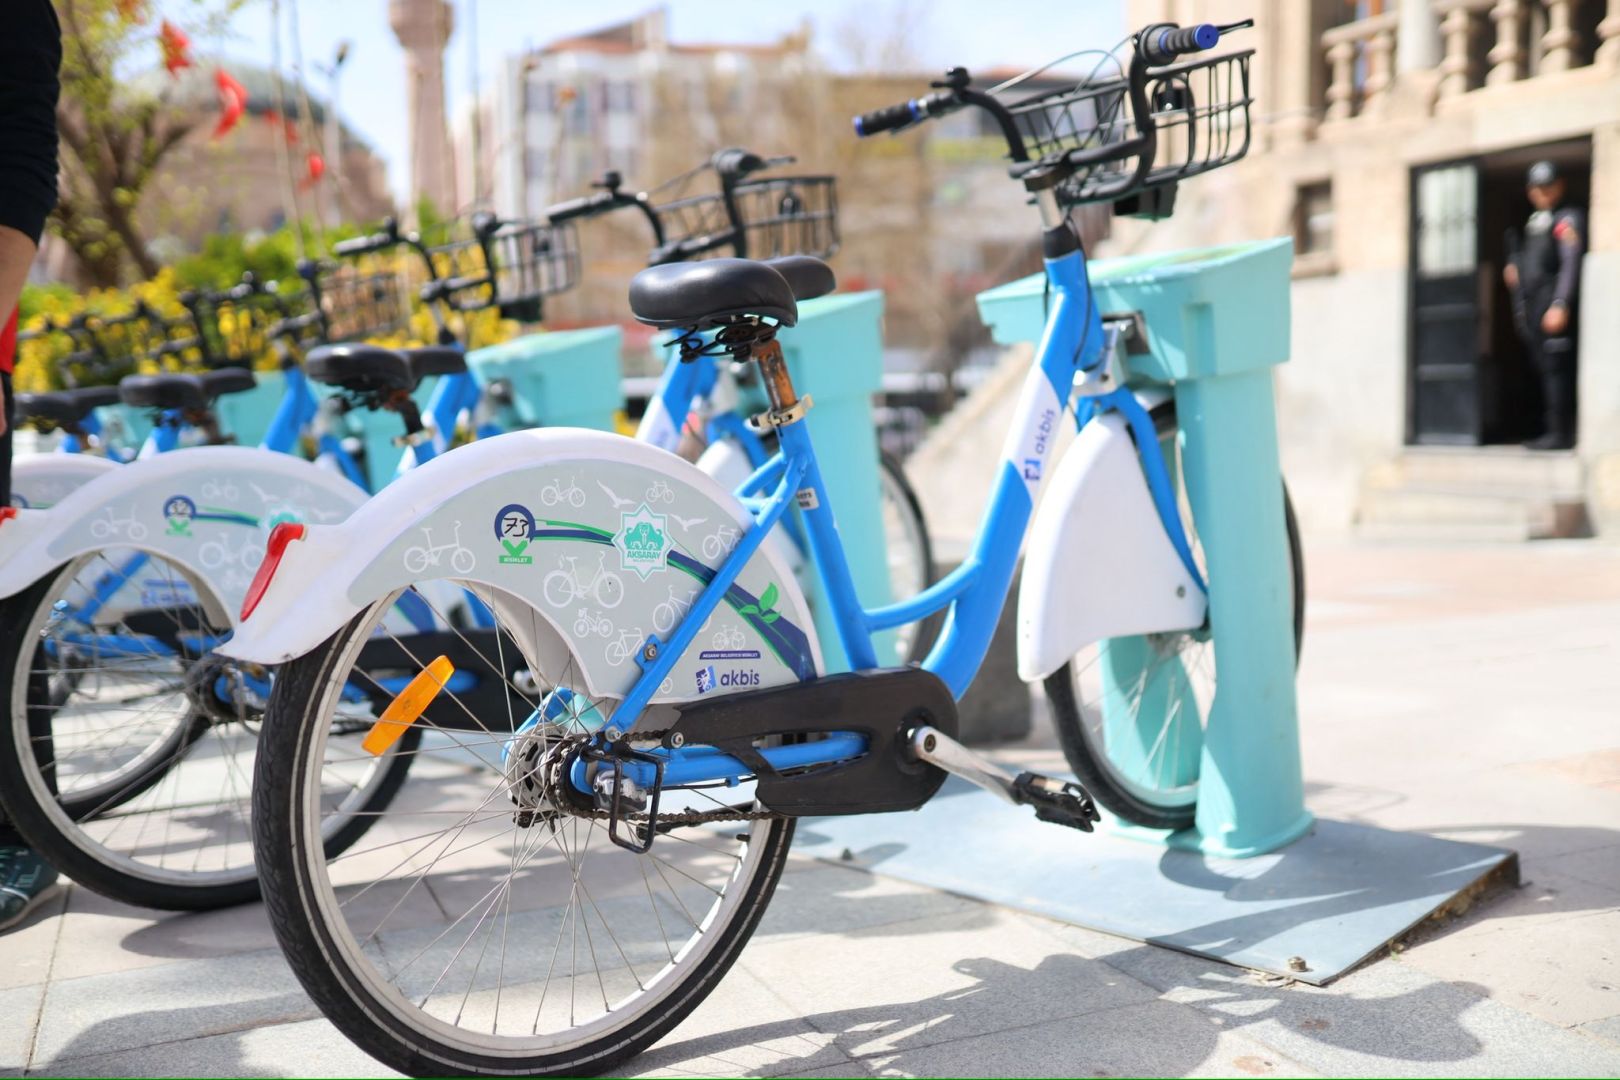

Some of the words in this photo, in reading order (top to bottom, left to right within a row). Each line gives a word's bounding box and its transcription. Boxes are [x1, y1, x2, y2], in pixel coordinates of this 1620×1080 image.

[1035, 408, 1055, 455] akbis
[503, 517, 529, 537] 73
[627, 550, 660, 560] AKSARAY
[720, 669, 760, 686] akbis
